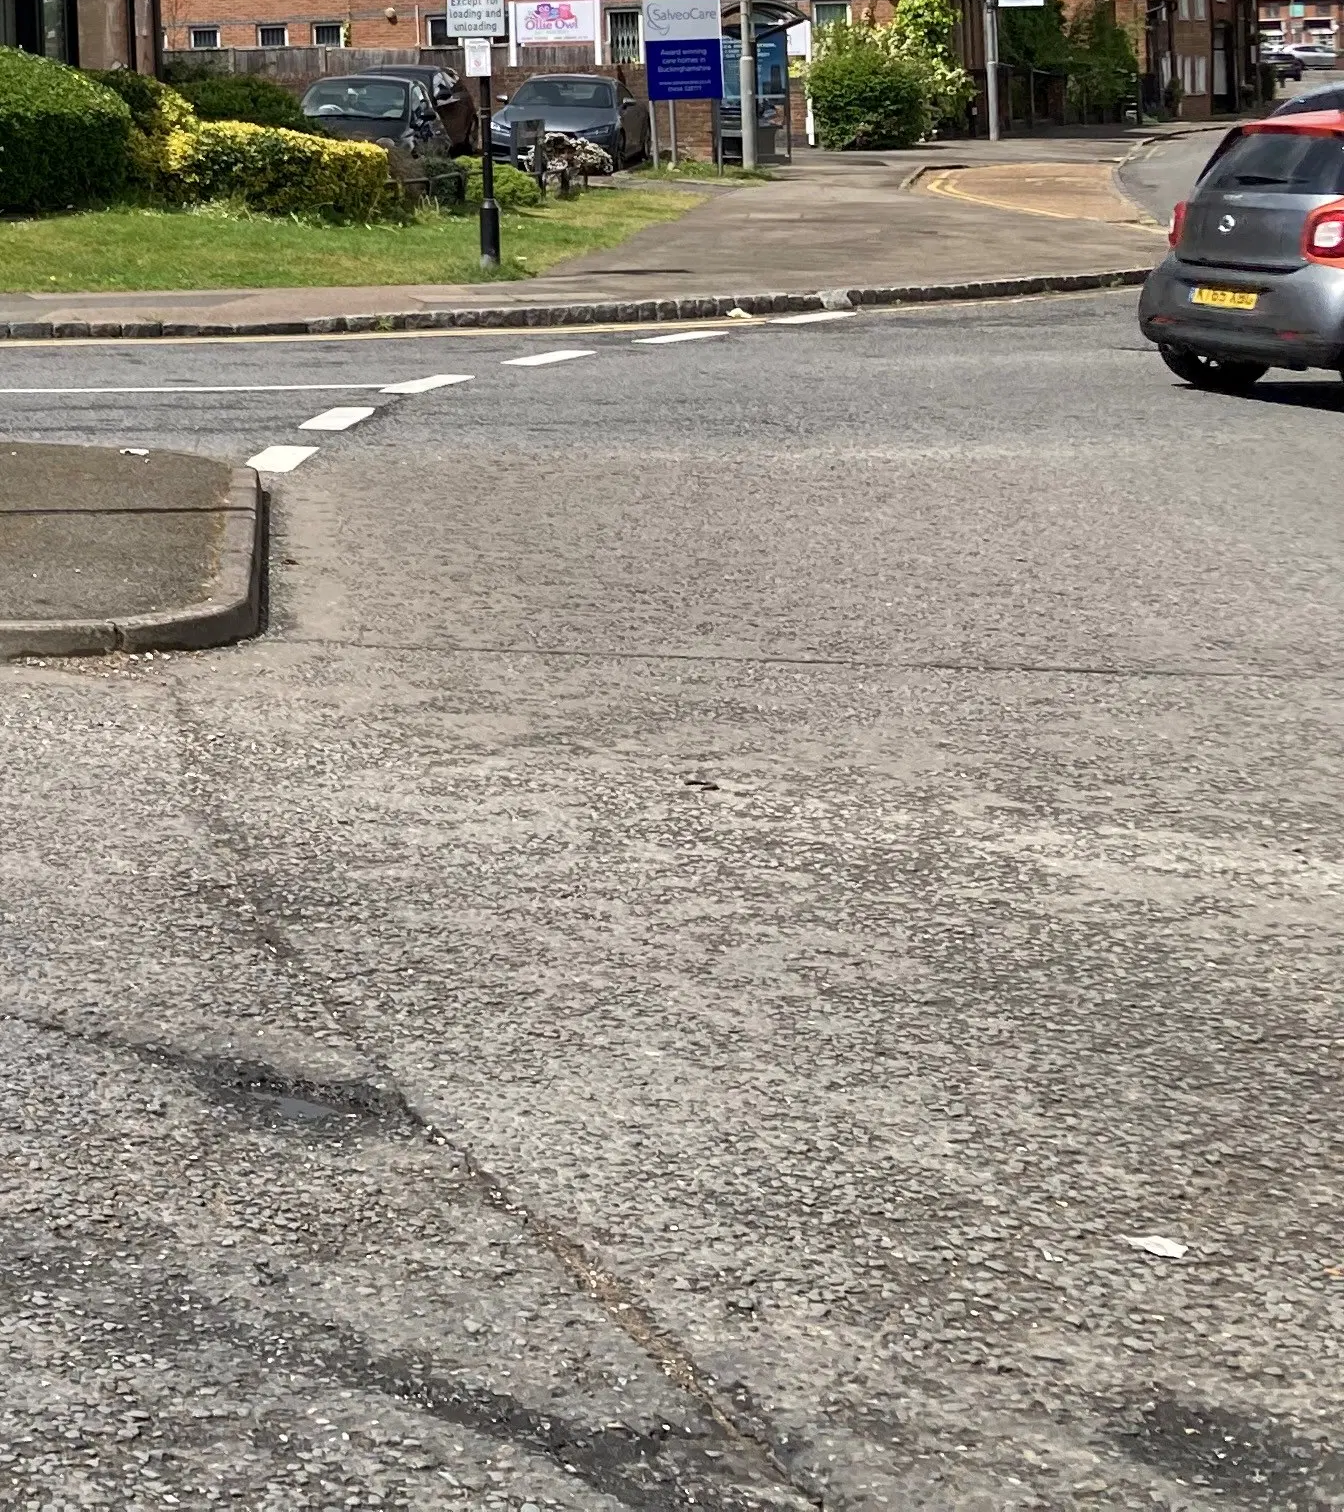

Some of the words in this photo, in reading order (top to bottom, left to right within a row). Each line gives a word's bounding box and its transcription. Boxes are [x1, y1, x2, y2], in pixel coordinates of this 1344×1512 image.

[449, 9, 482, 20] loading
[485, 8, 501, 18] and
[652, 8, 716, 20] SalveoCare
[454, 21, 497, 32] unloading
[525, 18, 553, 30] Ollie
[555, 15, 578, 29] Owl
